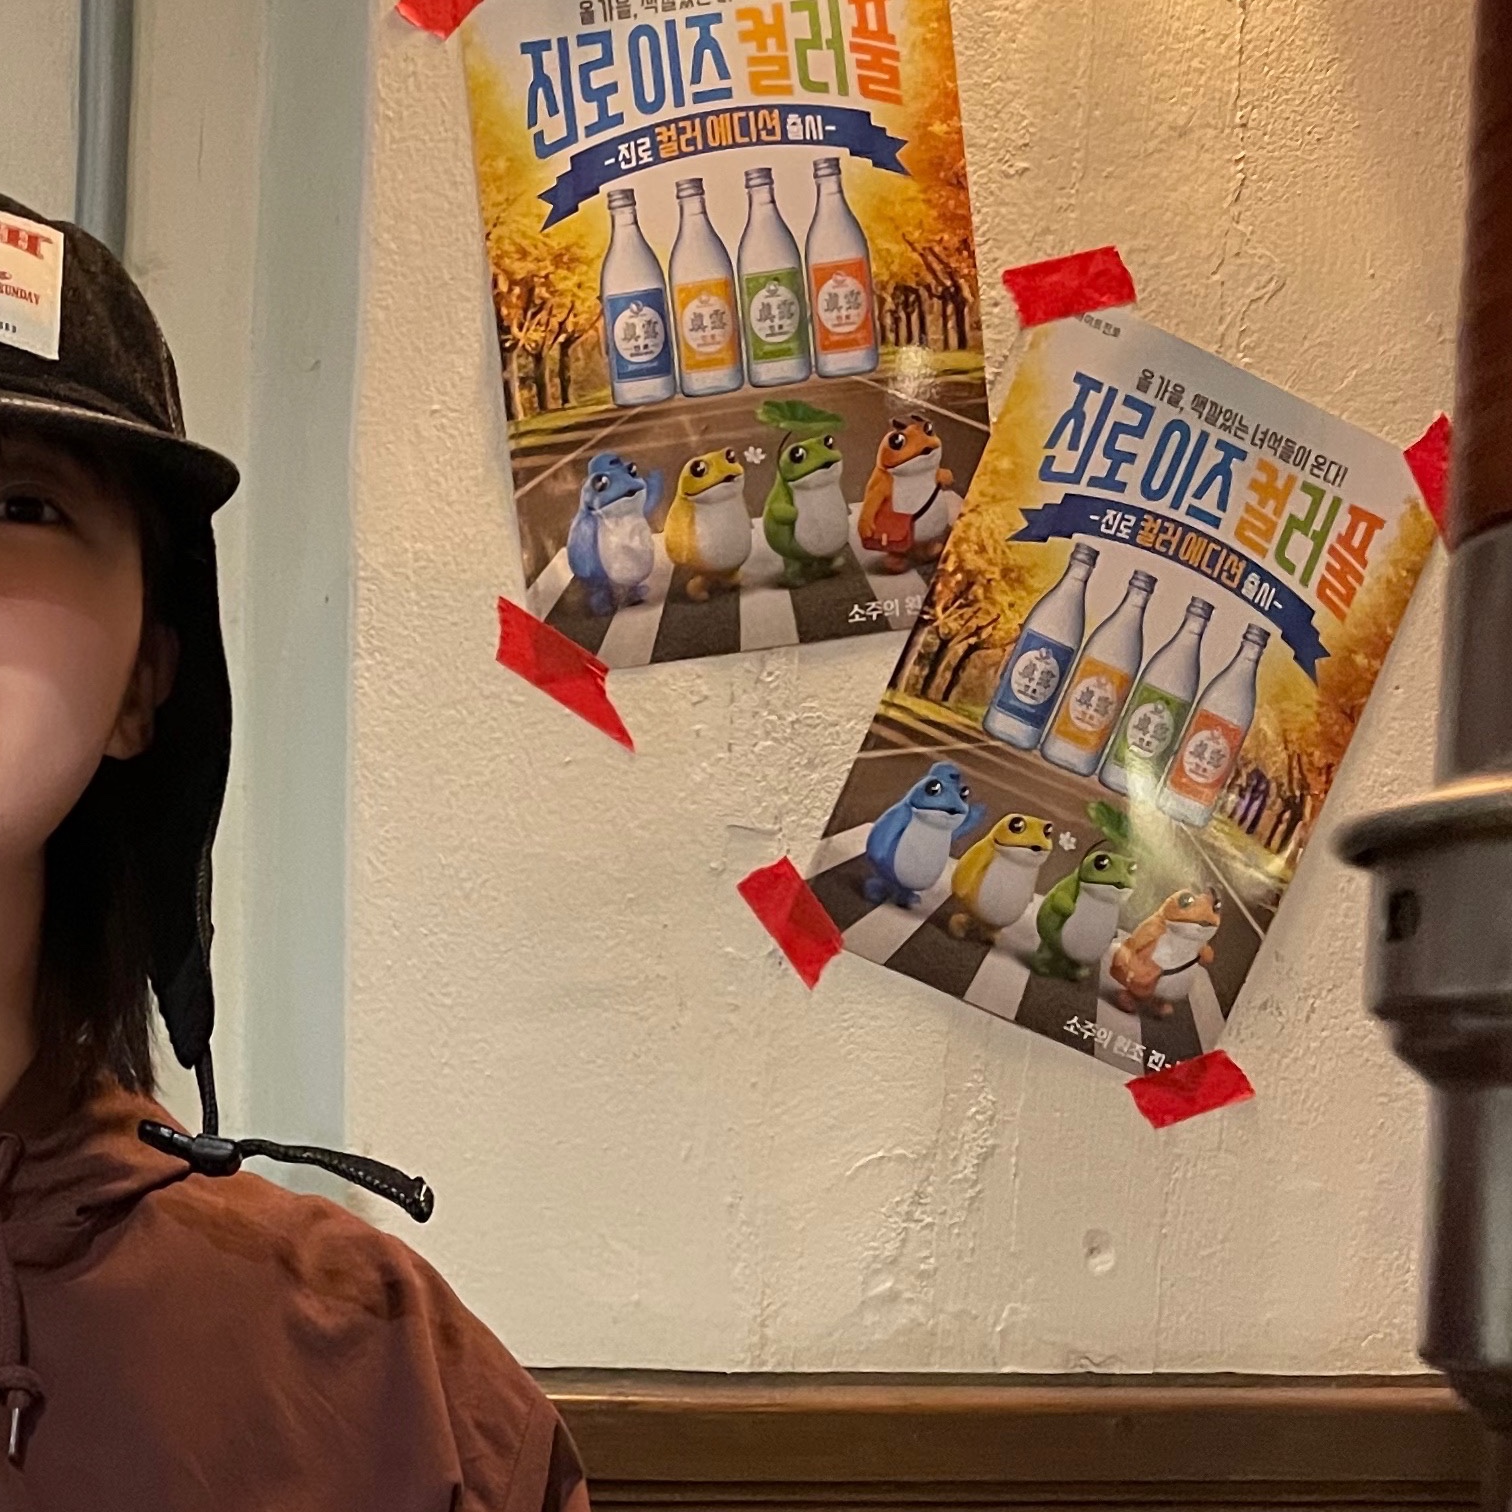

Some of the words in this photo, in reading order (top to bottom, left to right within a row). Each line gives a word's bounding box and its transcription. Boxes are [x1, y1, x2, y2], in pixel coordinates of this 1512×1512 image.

[520, 29, 625, 161] 진로
[627, 12, 733, 116] 이즈
[734, 0, 903, 106] 컬러풀
[655, 117, 703, 159] 컬러
[706, 108, 781, 147] 에디션
[1136, 368, 1155, 394] 올
[1154, 375, 1186, 413] 가을,
[1250, 423, 1313, 471] 녀석들이
[1309, 454, 1349, 488] 온다!
[1038, 371, 1157, 493] 진로
[1140, 418, 1248, 529] 이즈
[1233, 456, 1387, 624] 컬러풀
[1136, 513, 1183, 556] 컬러
[1178, 531, 1247, 589] 에디션
[848, 598, 900, 623] 소주의
[1063, 1015, 1114, 1050] 소주의
[1147, 1050, 1181, 1071] 진
